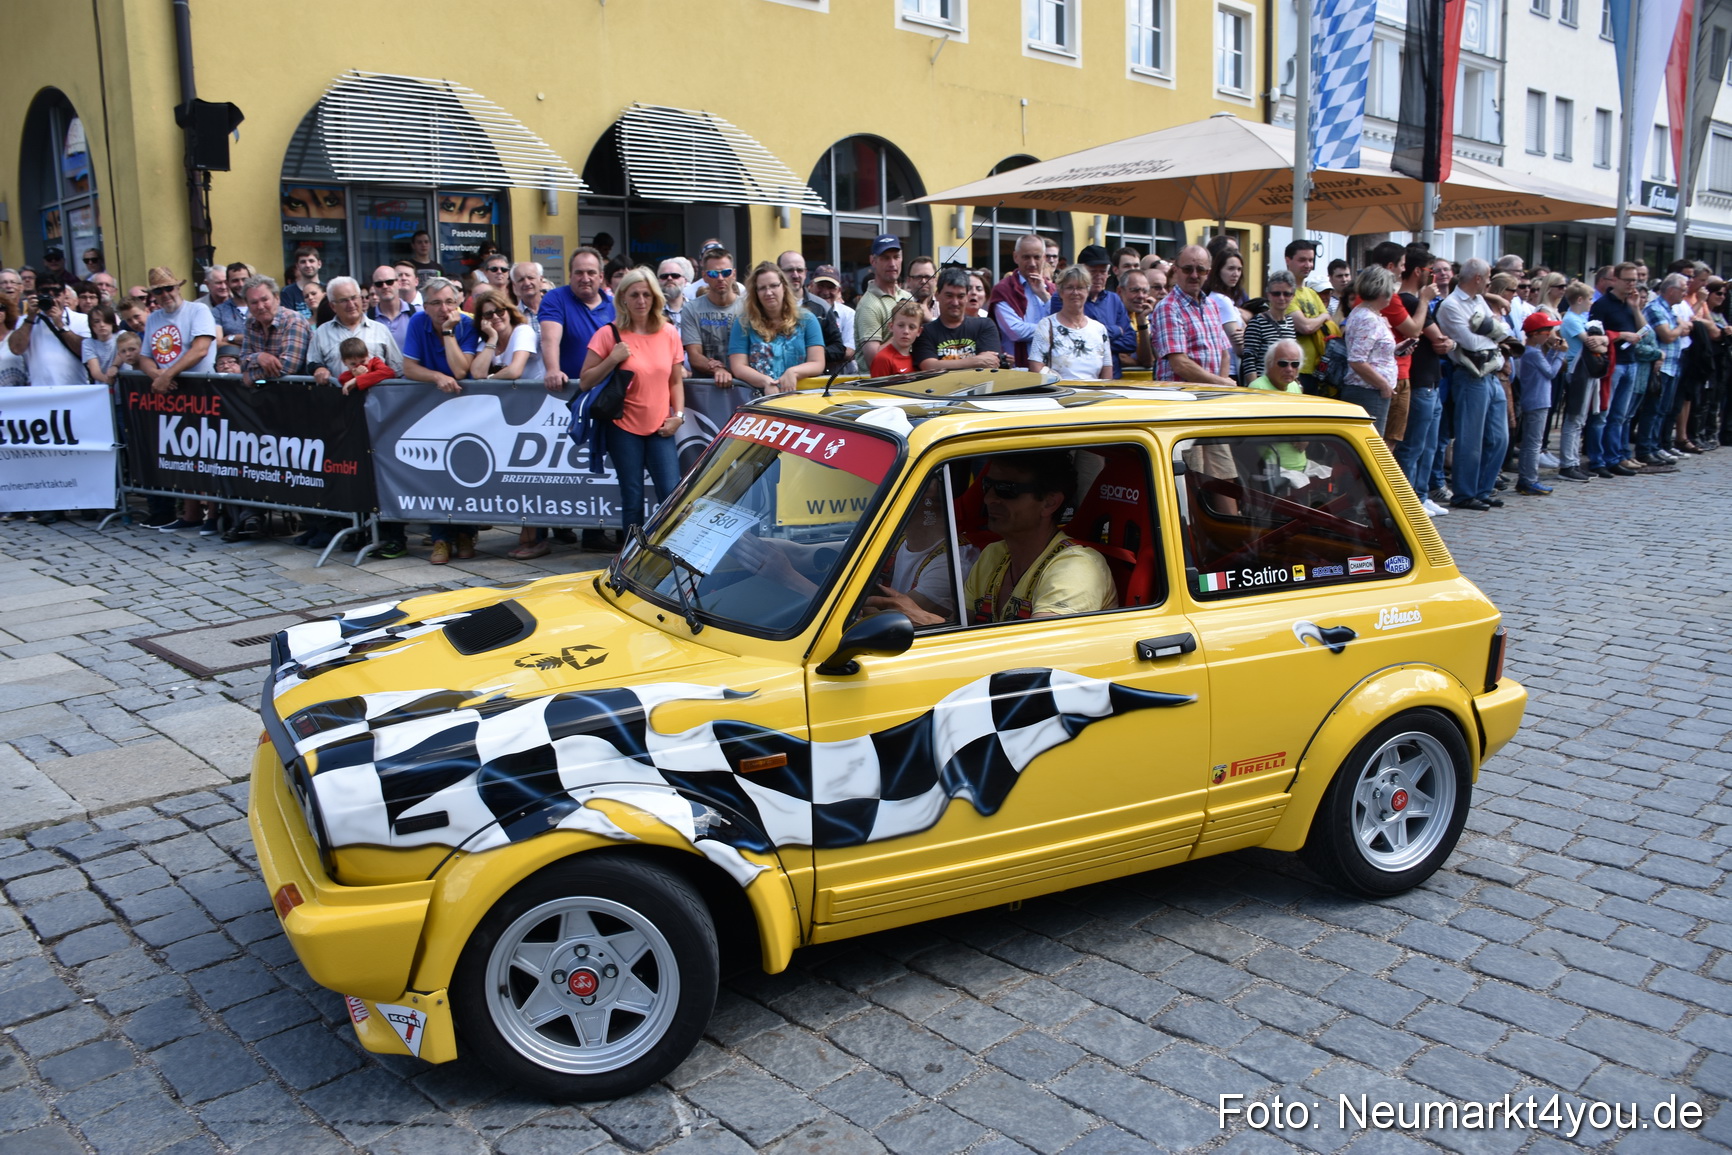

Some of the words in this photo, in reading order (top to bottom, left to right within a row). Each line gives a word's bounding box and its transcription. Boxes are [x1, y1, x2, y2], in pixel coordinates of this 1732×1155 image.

[283, 224, 313, 235] Digitale
[315, 225, 338, 234] Bilder
[451, 229, 487, 238] Passbilder
[156, 351, 177, 362] 1758
[129, 392, 221, 416] FAHRSCHULE
[542, 412, 569, 427] Au
[725, 415, 826, 454] ABARTH
[159, 414, 325, 473] Kohlmann
[324, 459, 358, 476] GmbH
[507, 432, 614, 470] Die
[159, 457, 194, 472] Neumarkt
[242, 466, 280, 483] Freystadt
[285, 471, 324, 488] Pyrbaum
[501, 474, 584, 485] BREITENBRUNN
[1100, 484, 1140, 501] sparco
[709, 512, 739, 529] 580
[1374, 606, 1422, 630] Schuco
[1230, 751, 1286, 777] PIRELLI
[389, 1014, 420, 1027] KONI
